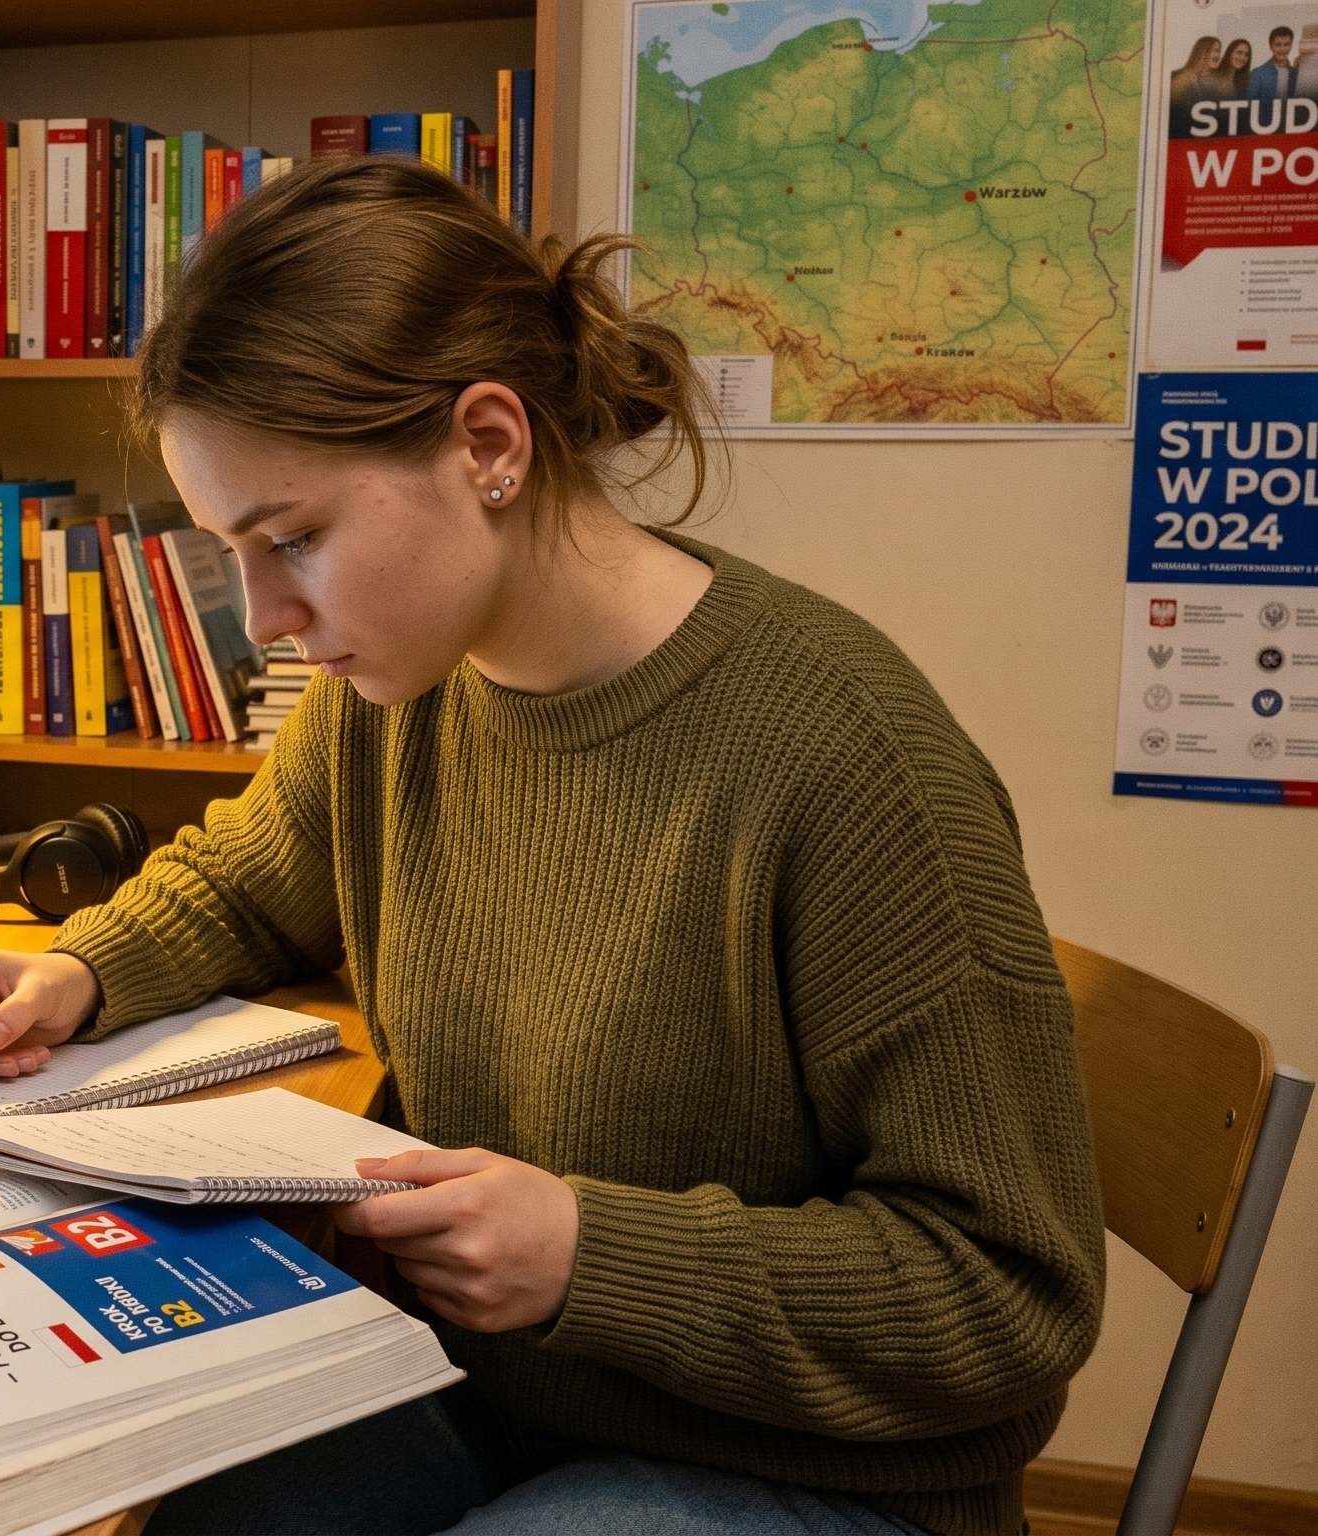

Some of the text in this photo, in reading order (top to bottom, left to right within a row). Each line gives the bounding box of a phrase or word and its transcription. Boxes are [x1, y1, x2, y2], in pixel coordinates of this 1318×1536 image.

[1190, 97, 1318, 137] STUD
[1186, 146, 1318, 188] W PO
[1158, 420, 1318, 460] STUDI
[1157, 466, 1212, 504] W
[1153, 511, 1284, 551] 2024
[67, 1215, 139, 1250] B2
[99, 1304, 148, 1341] KROK
[143, 1315, 174, 1335] PO
[160, 1299, 206, 1328] B2
